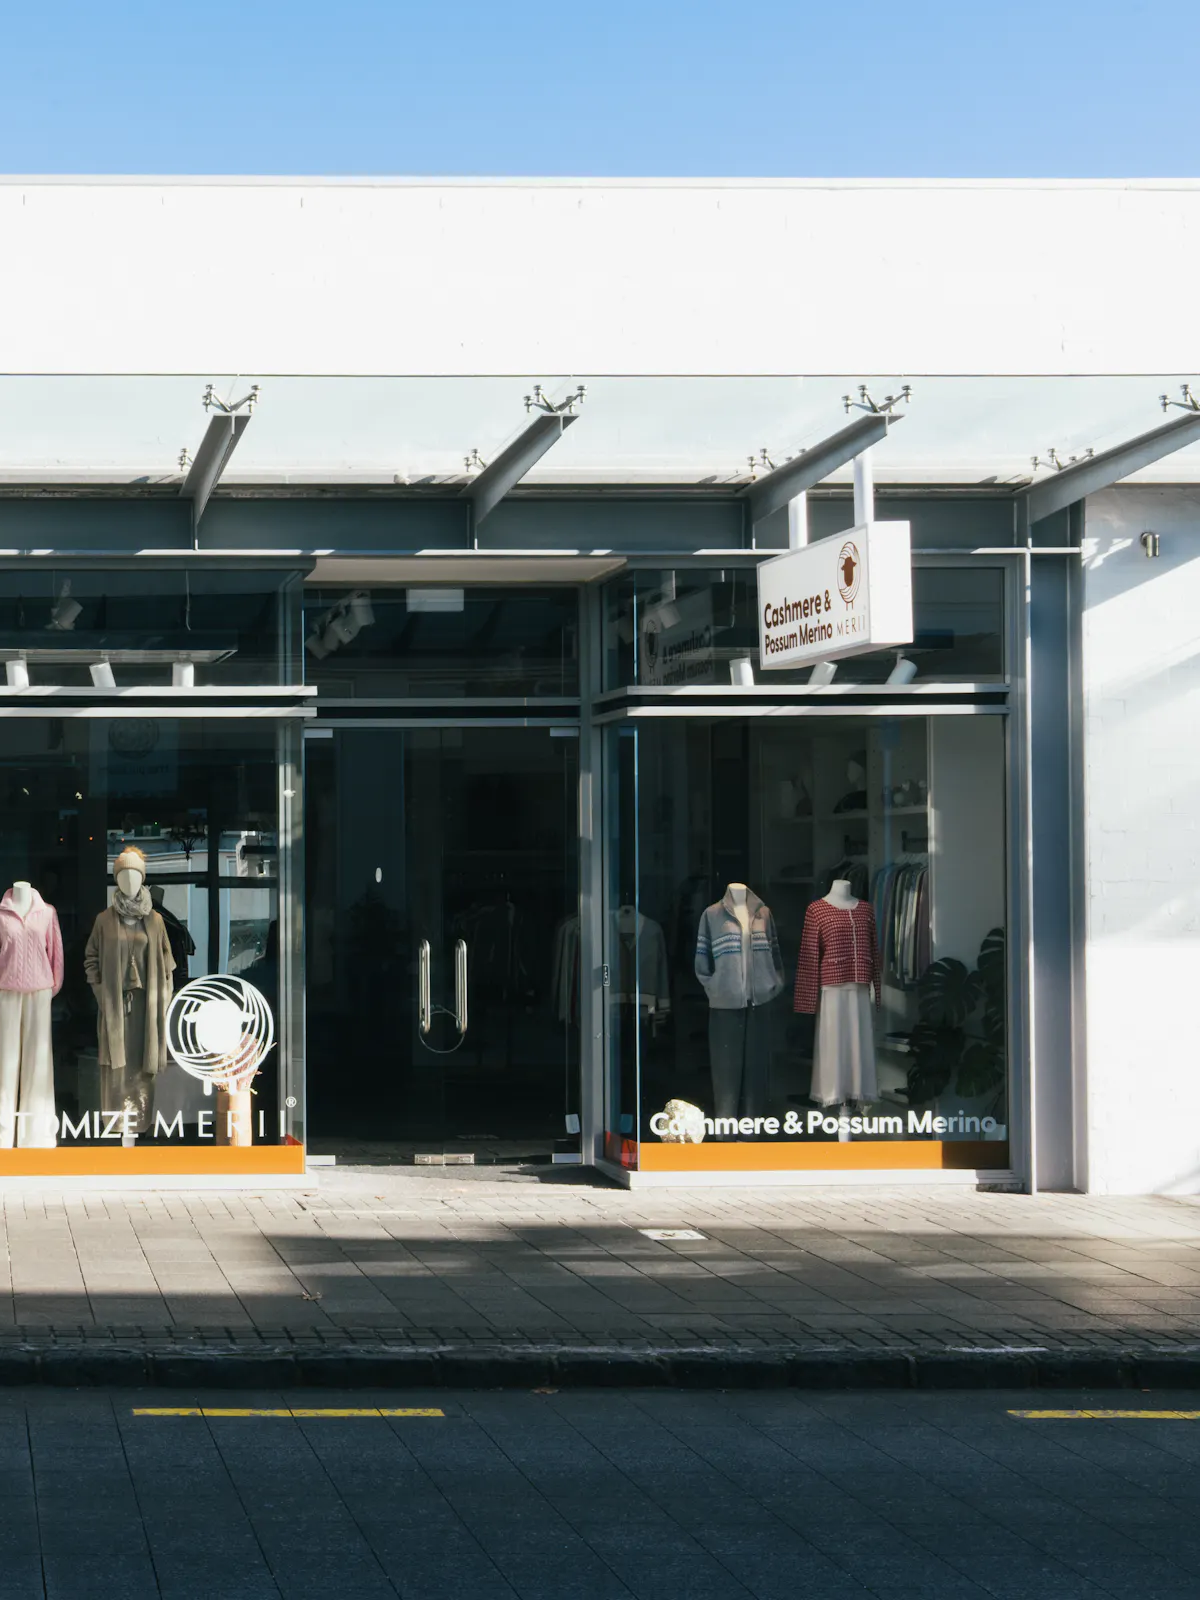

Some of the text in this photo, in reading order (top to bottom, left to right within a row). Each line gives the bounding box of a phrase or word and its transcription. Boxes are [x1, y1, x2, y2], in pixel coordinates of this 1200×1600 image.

[763, 589, 832, 630] Cashmere &
[765, 618, 833, 656] Possum Merino
[783, 1110, 804, 1135] &
[807, 1110, 903, 1135] Possum
[907, 1109, 997, 1134] Merino
